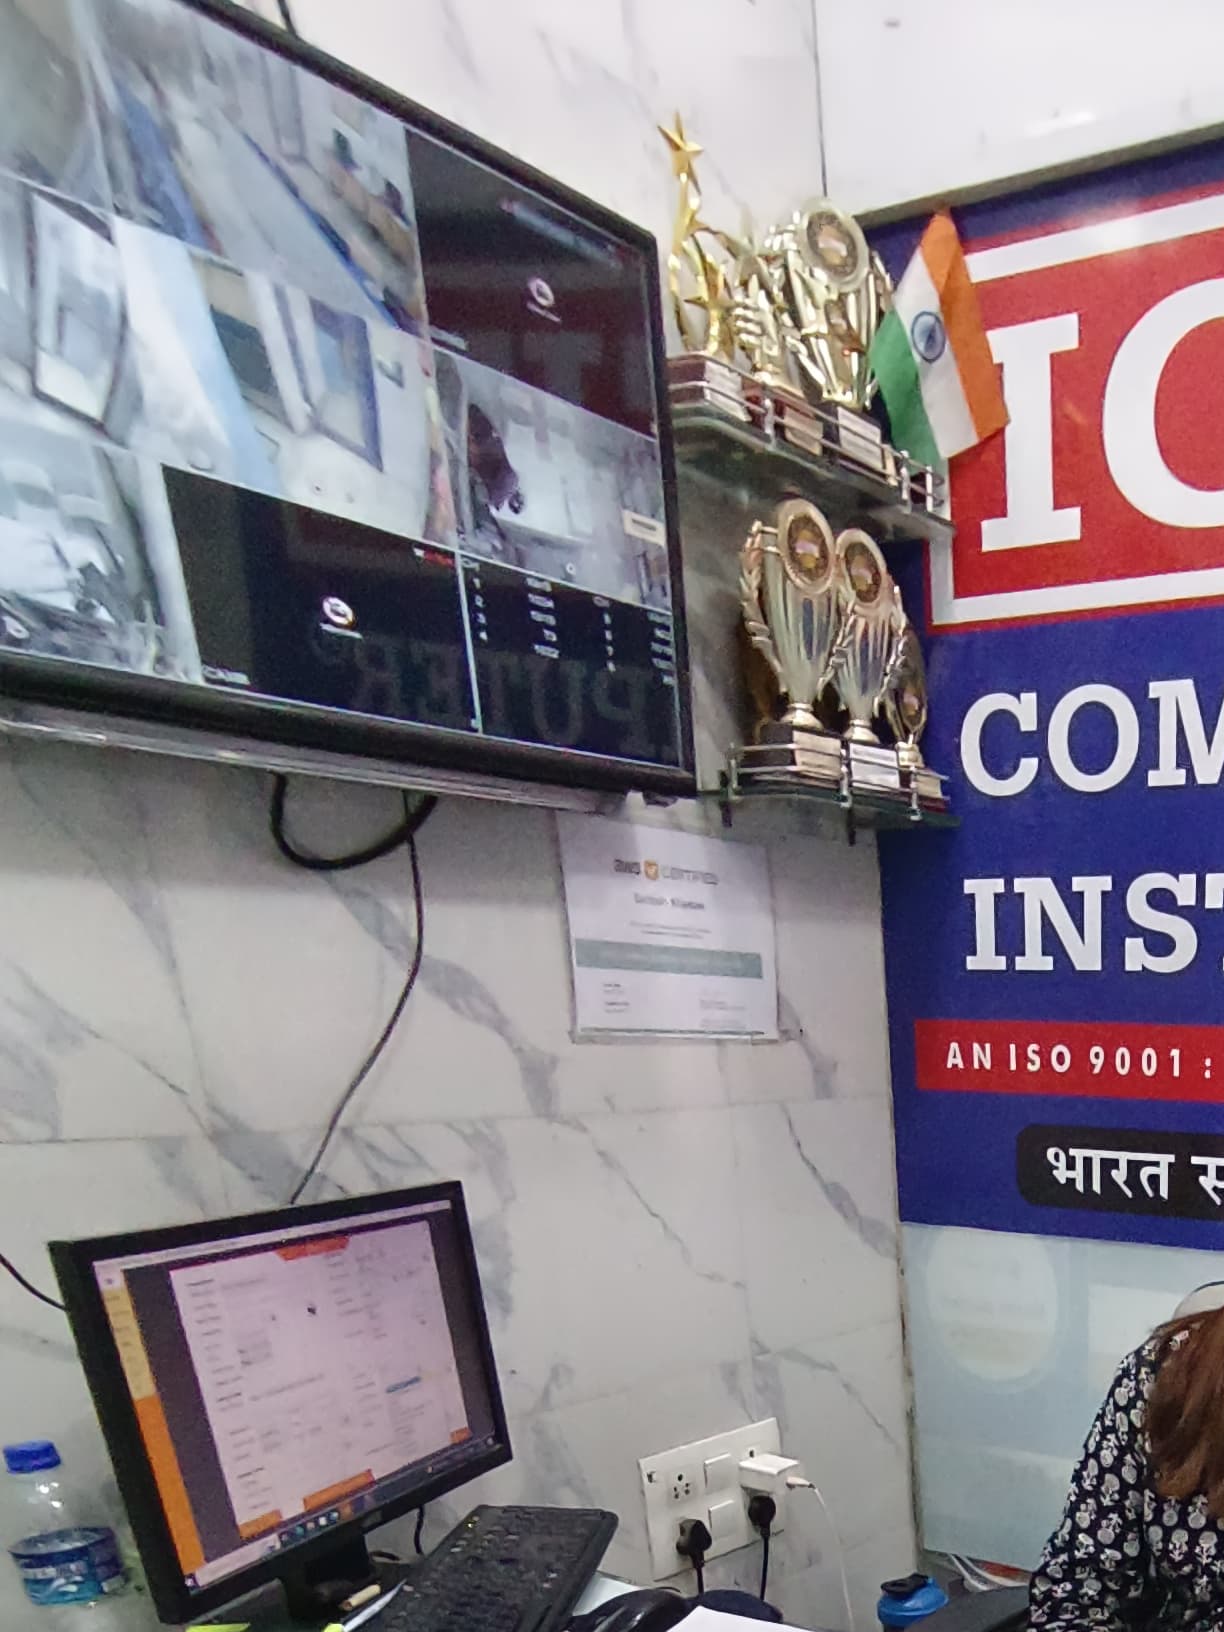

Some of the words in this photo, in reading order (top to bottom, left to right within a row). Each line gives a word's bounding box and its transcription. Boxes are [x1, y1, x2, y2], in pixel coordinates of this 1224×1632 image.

[946, 1042, 992, 1070] AN
[1009, 1043, 1071, 1073] ISO
[1090, 1046, 1180, 1077] 9001
[1046, 1146, 1176, 1201] भारत
